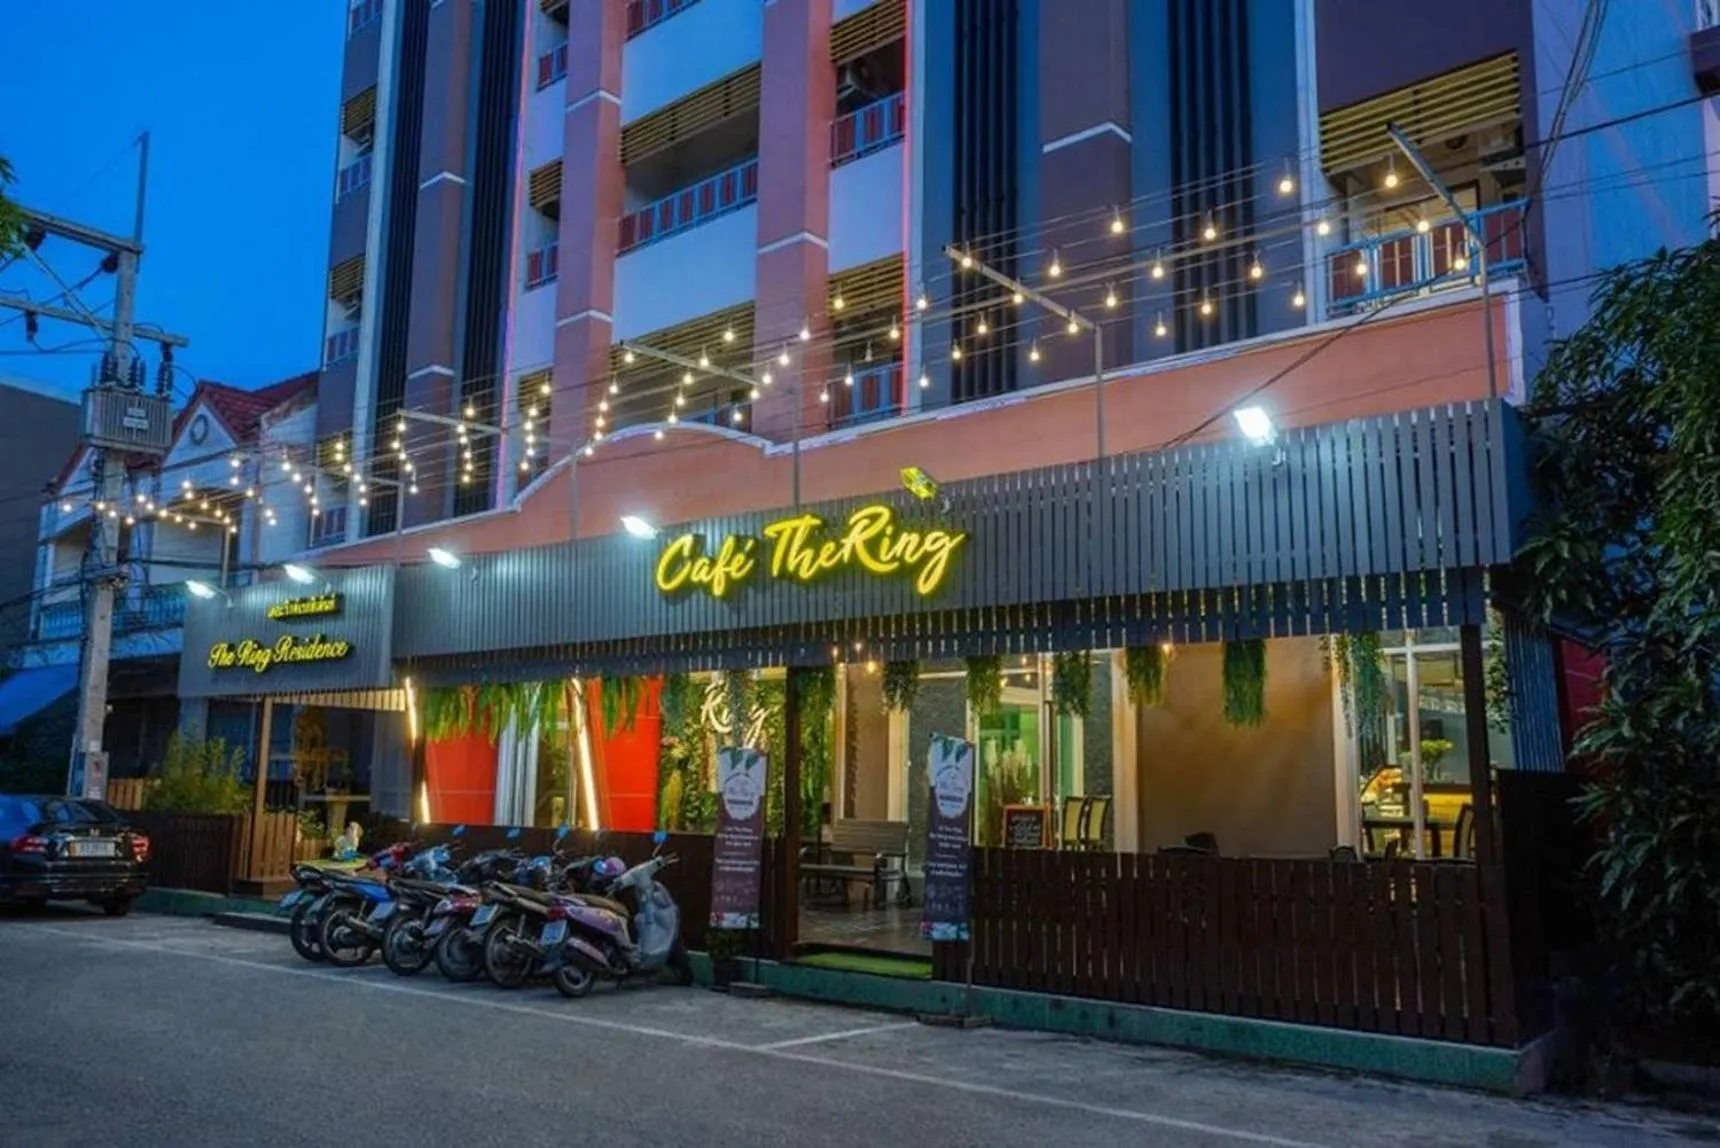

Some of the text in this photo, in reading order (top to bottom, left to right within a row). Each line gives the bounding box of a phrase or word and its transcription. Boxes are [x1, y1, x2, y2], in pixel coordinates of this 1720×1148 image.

[656, 534, 755, 597] Café
[207, 633, 349, 673] The Ring Residence
